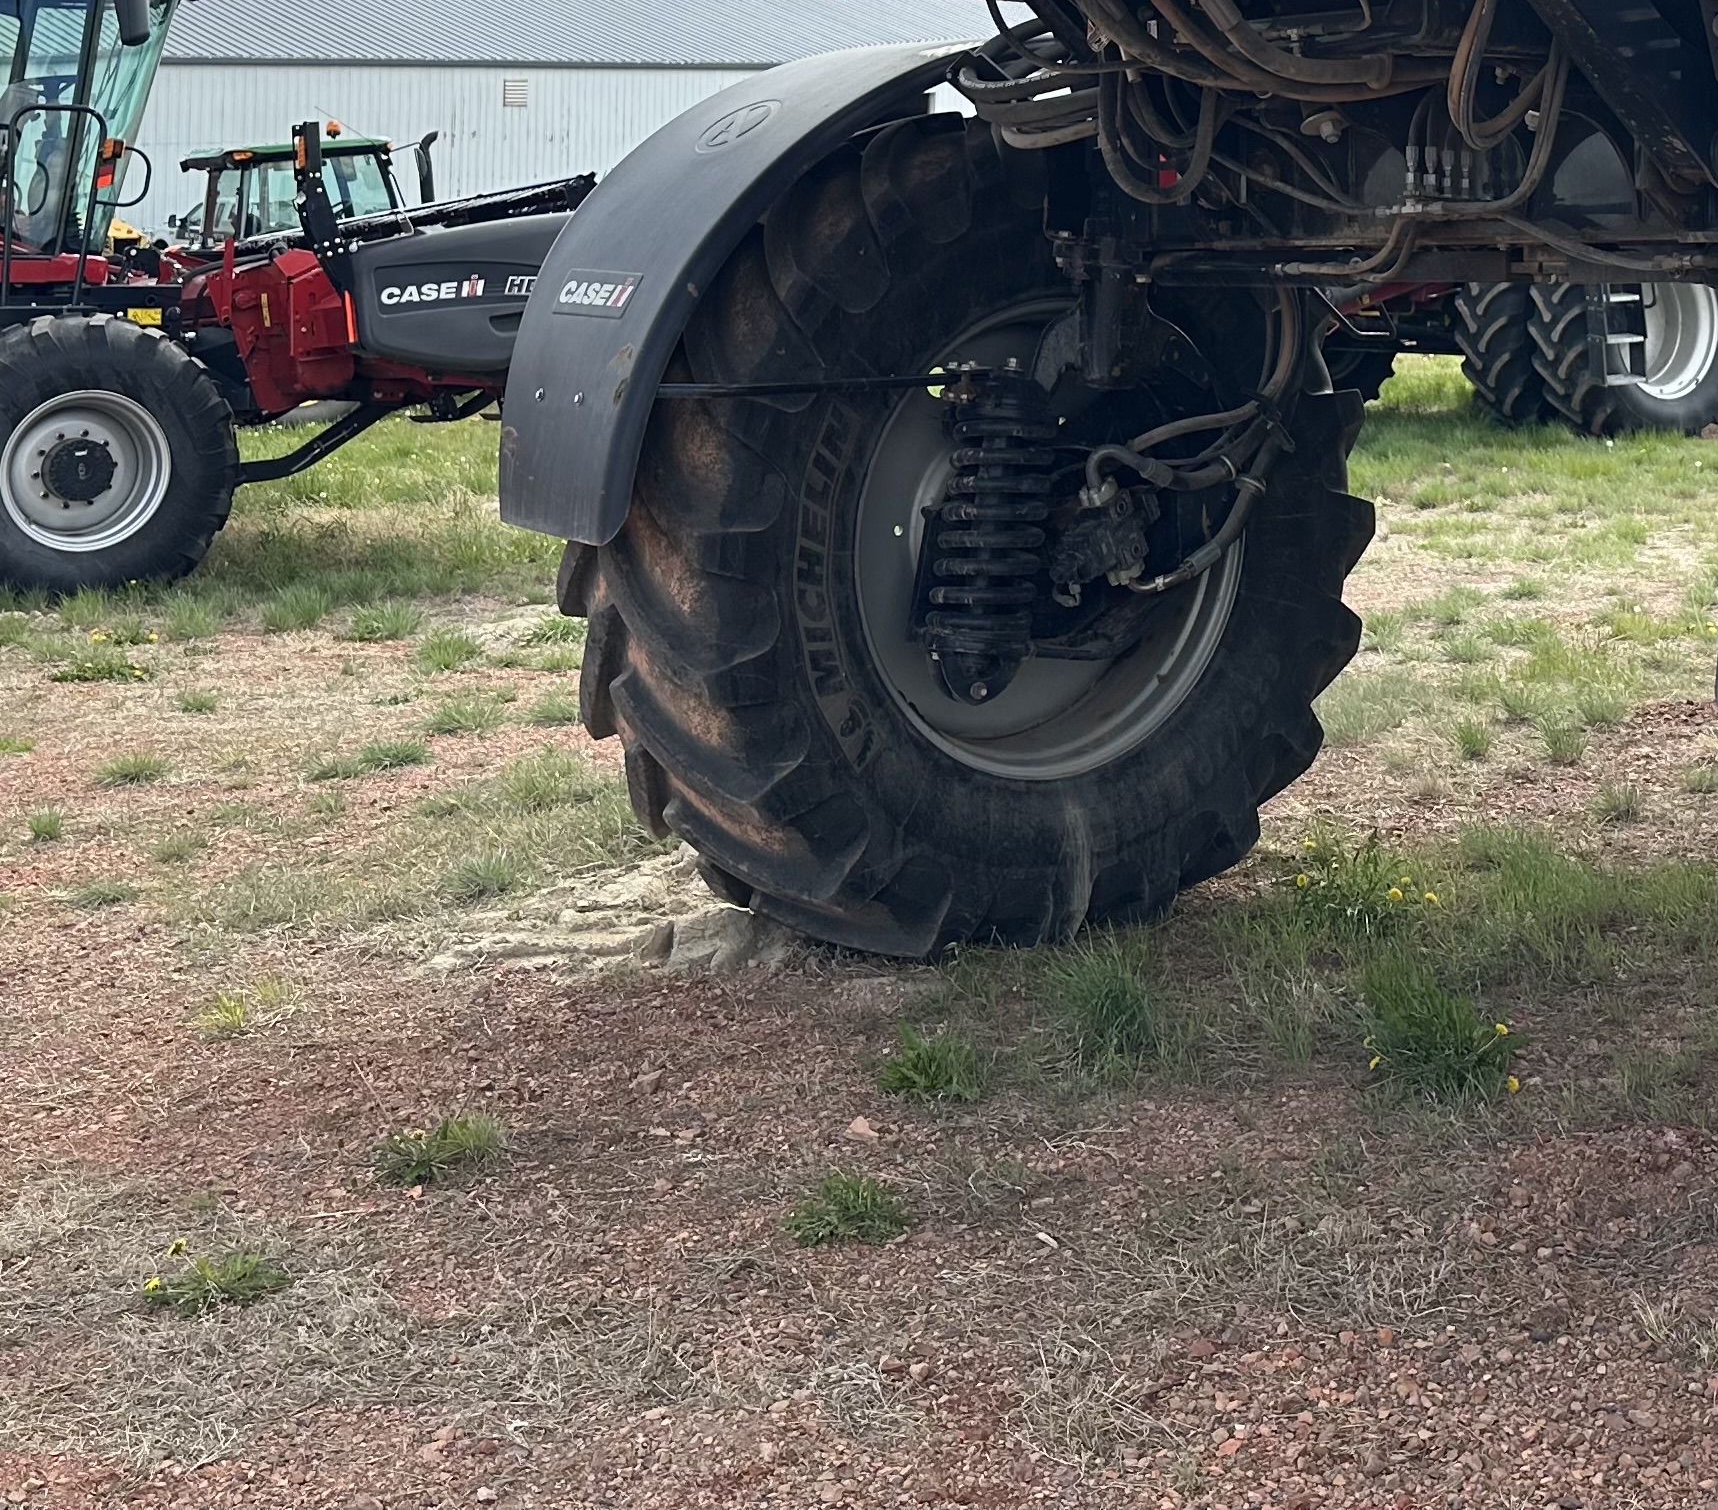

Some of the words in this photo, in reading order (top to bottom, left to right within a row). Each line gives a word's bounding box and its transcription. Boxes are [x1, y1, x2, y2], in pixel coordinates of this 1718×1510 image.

[381, 281, 458, 305] CASE
[559, 280, 615, 306] CASE
[797, 402, 852, 699] MICHELIN
